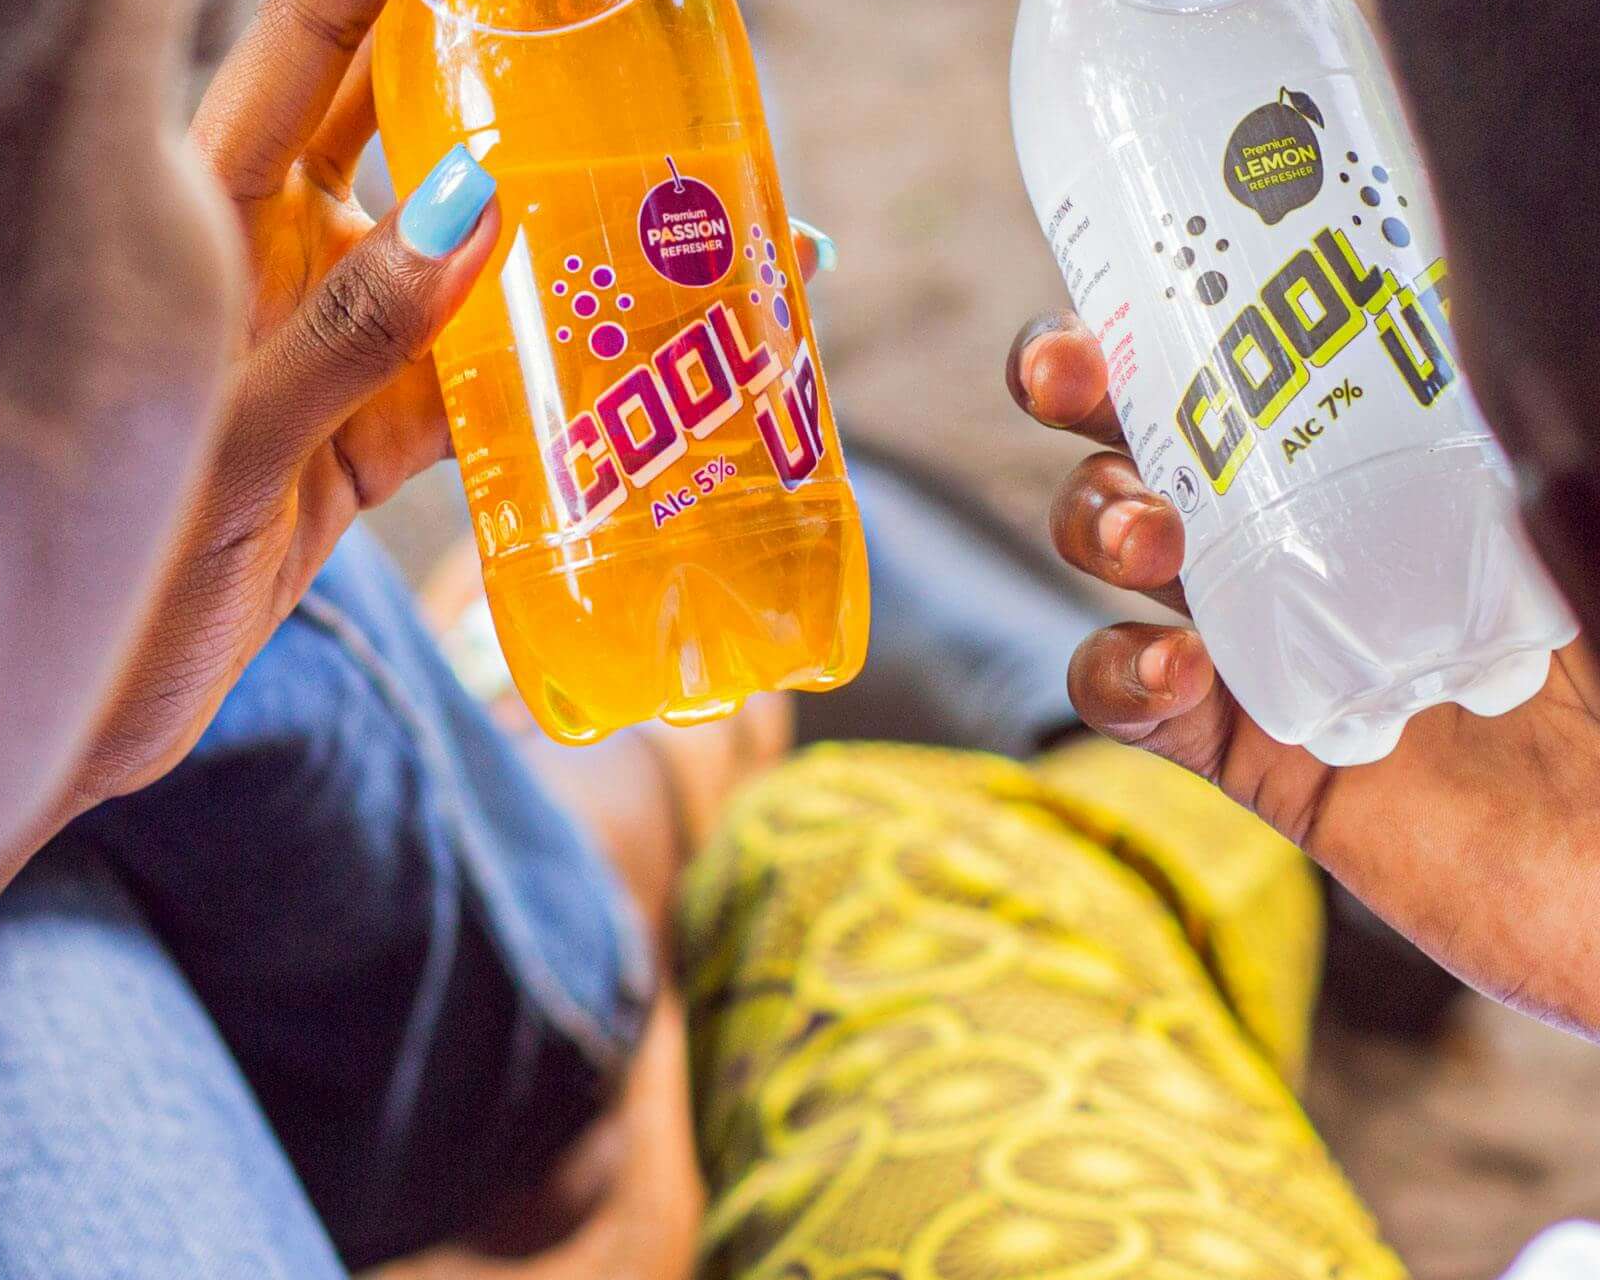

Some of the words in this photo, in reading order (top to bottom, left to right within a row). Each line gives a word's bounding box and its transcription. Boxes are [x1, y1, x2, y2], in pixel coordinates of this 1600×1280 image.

[1234, 144, 1317, 183] LEMON
[1242, 136, 1297, 158] Premium
[1248, 166, 1314, 192] REFRESHER
[646, 218, 726, 247] PASSION
[662, 208, 708, 224] Premium
[660, 239, 724, 259] REFRESHER
[1176, 227, 1400, 496] COOL
[545, 299, 782, 531] COOL
[752, 336, 825, 494] UP
[1281, 417, 1325, 465] Alc
[1317, 378, 1363, 420] 7%
[652, 490, 697, 528] Alc
[692, 454, 736, 494] 5%
